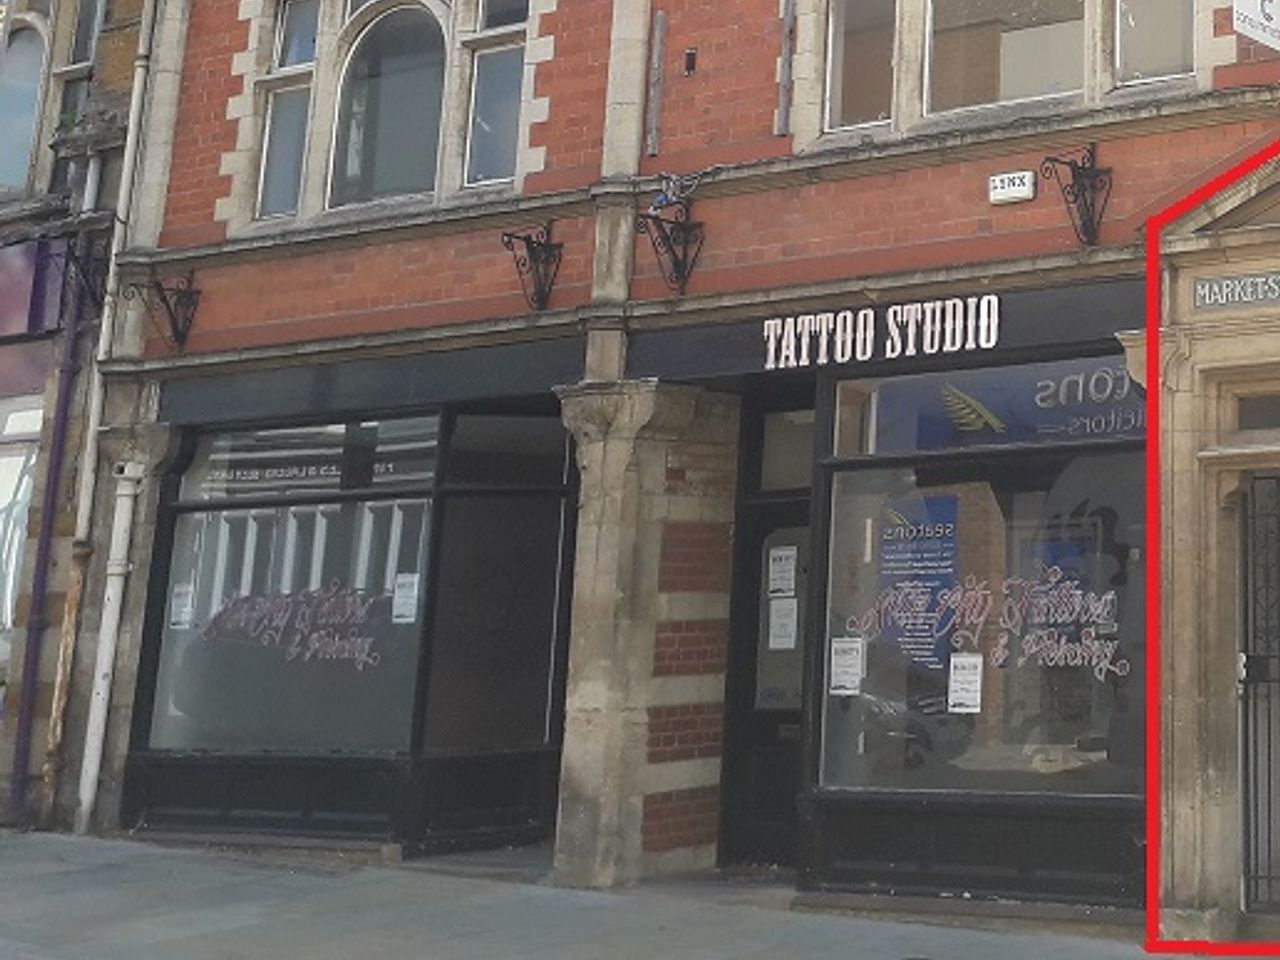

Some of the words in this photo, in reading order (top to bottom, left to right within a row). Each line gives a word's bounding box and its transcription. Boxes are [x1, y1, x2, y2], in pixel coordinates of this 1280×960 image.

[1195, 278, 1265, 306] MARKET
[764, 308, 875, 369] TATTOO
[885, 294, 999, 359] STUDIO
